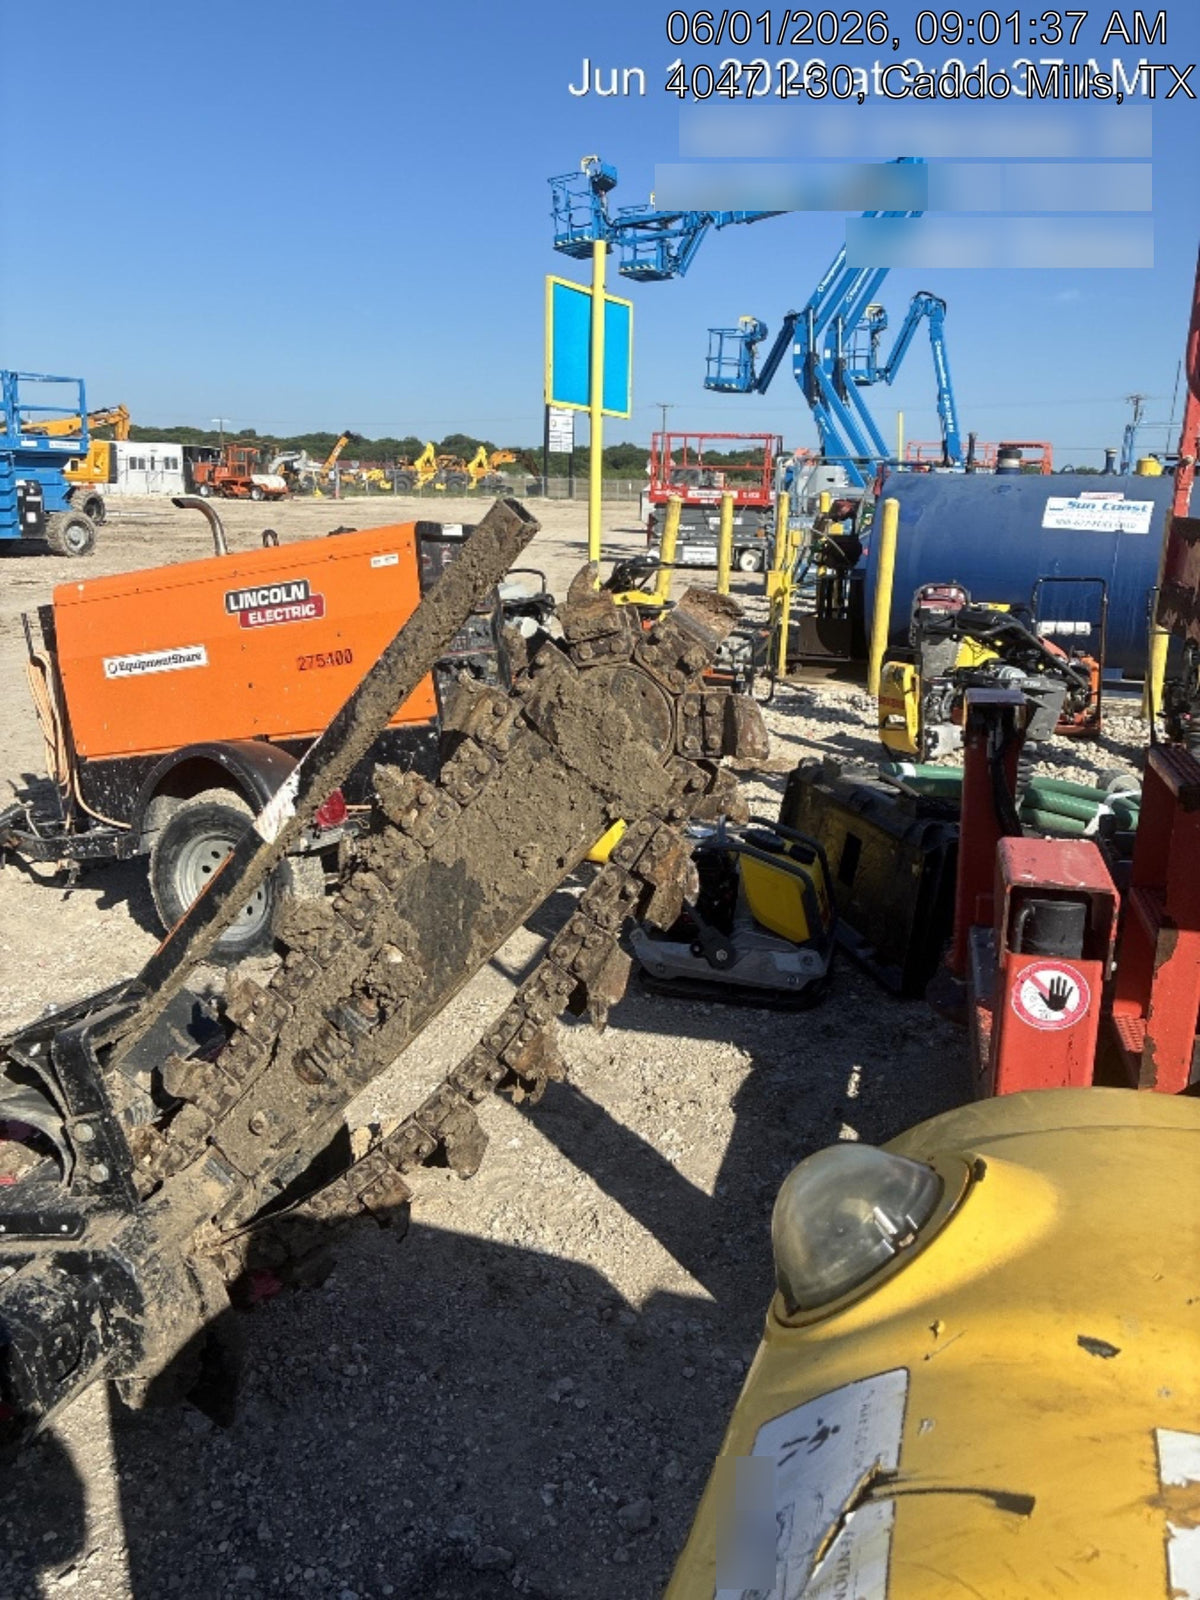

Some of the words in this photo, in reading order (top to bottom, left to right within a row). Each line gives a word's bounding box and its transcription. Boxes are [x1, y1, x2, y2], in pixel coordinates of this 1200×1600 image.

[1066, 500, 1097, 511] Sun
[228, 583, 305, 611] LINCOLN
[248, 603, 316, 625] ELECTRIC
